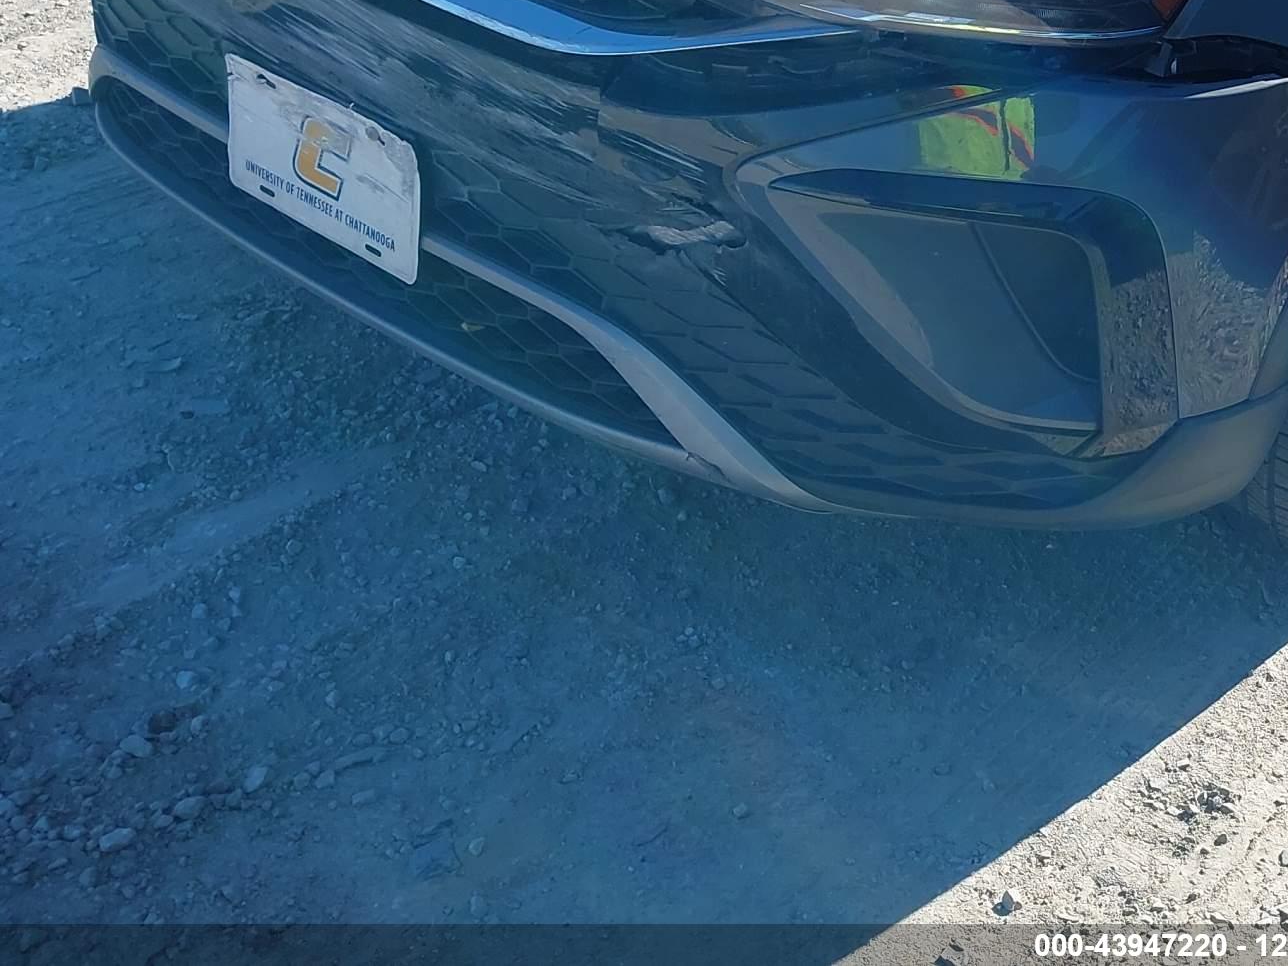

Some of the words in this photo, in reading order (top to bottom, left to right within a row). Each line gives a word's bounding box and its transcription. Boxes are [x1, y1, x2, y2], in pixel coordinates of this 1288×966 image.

[245, 159, 285, 190] UNIVERSITY
[285, 181, 295, 195] OF
[296, 185, 334, 218] TENNESSEE
[335, 208, 343, 222] AT
[345, 213, 396, 252] CHATTANOOGA
